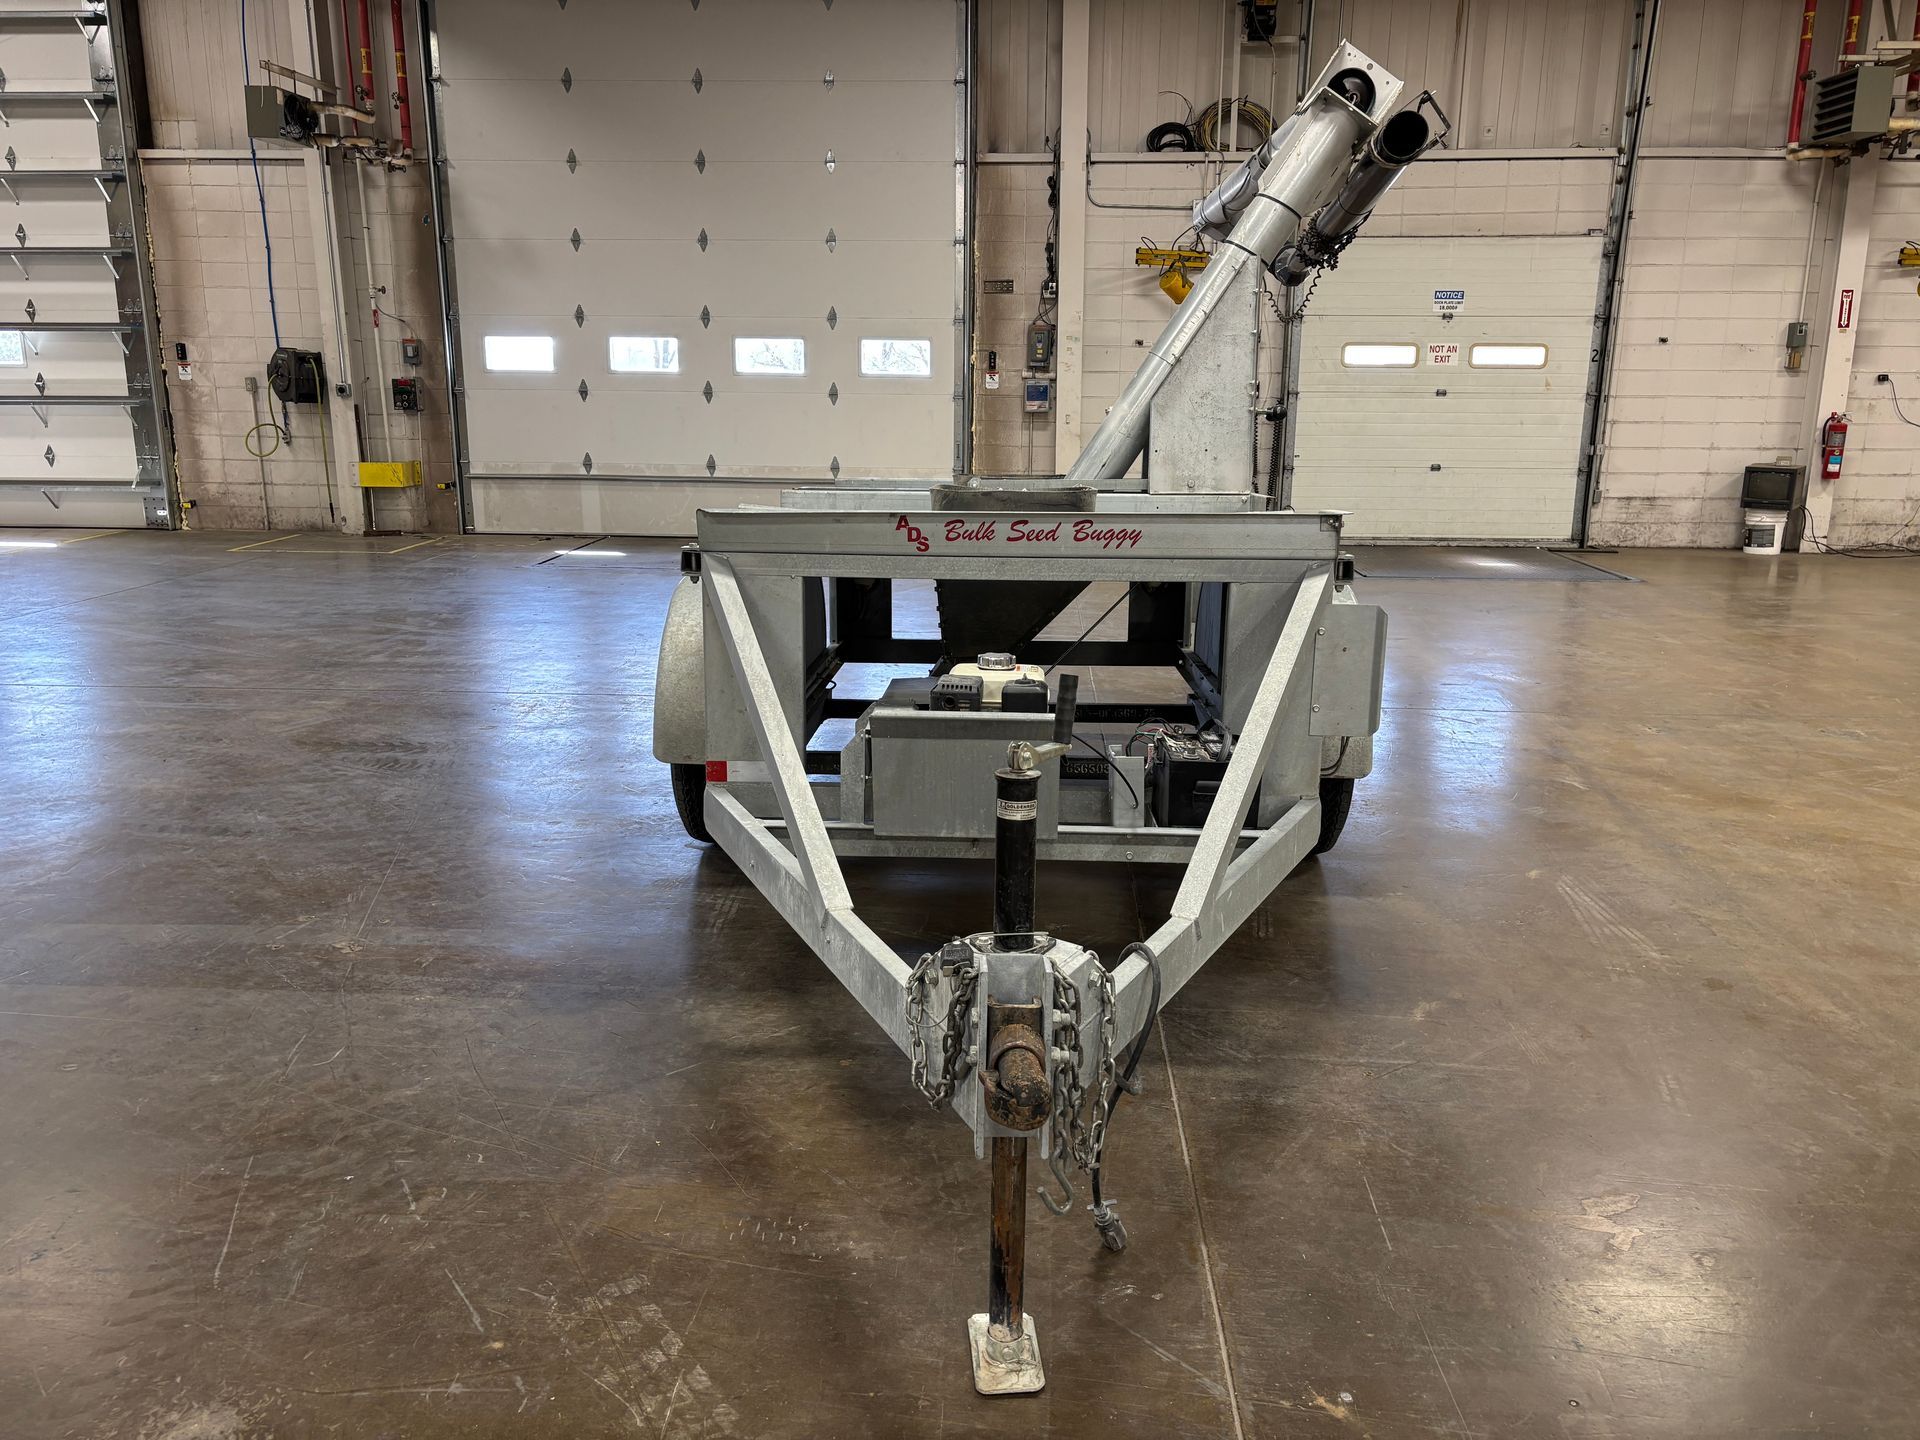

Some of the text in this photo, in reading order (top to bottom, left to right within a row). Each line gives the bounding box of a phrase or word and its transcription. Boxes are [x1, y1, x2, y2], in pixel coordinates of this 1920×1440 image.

[1435, 291, 1464, 299] NOTICE
[1429, 345, 1458, 354] NOT AN
[1434, 355, 1451, 364] EXIT
[1591, 348, 1599, 363] 2
[943, 518, 1143, 550] Bulk Seed Buggy
